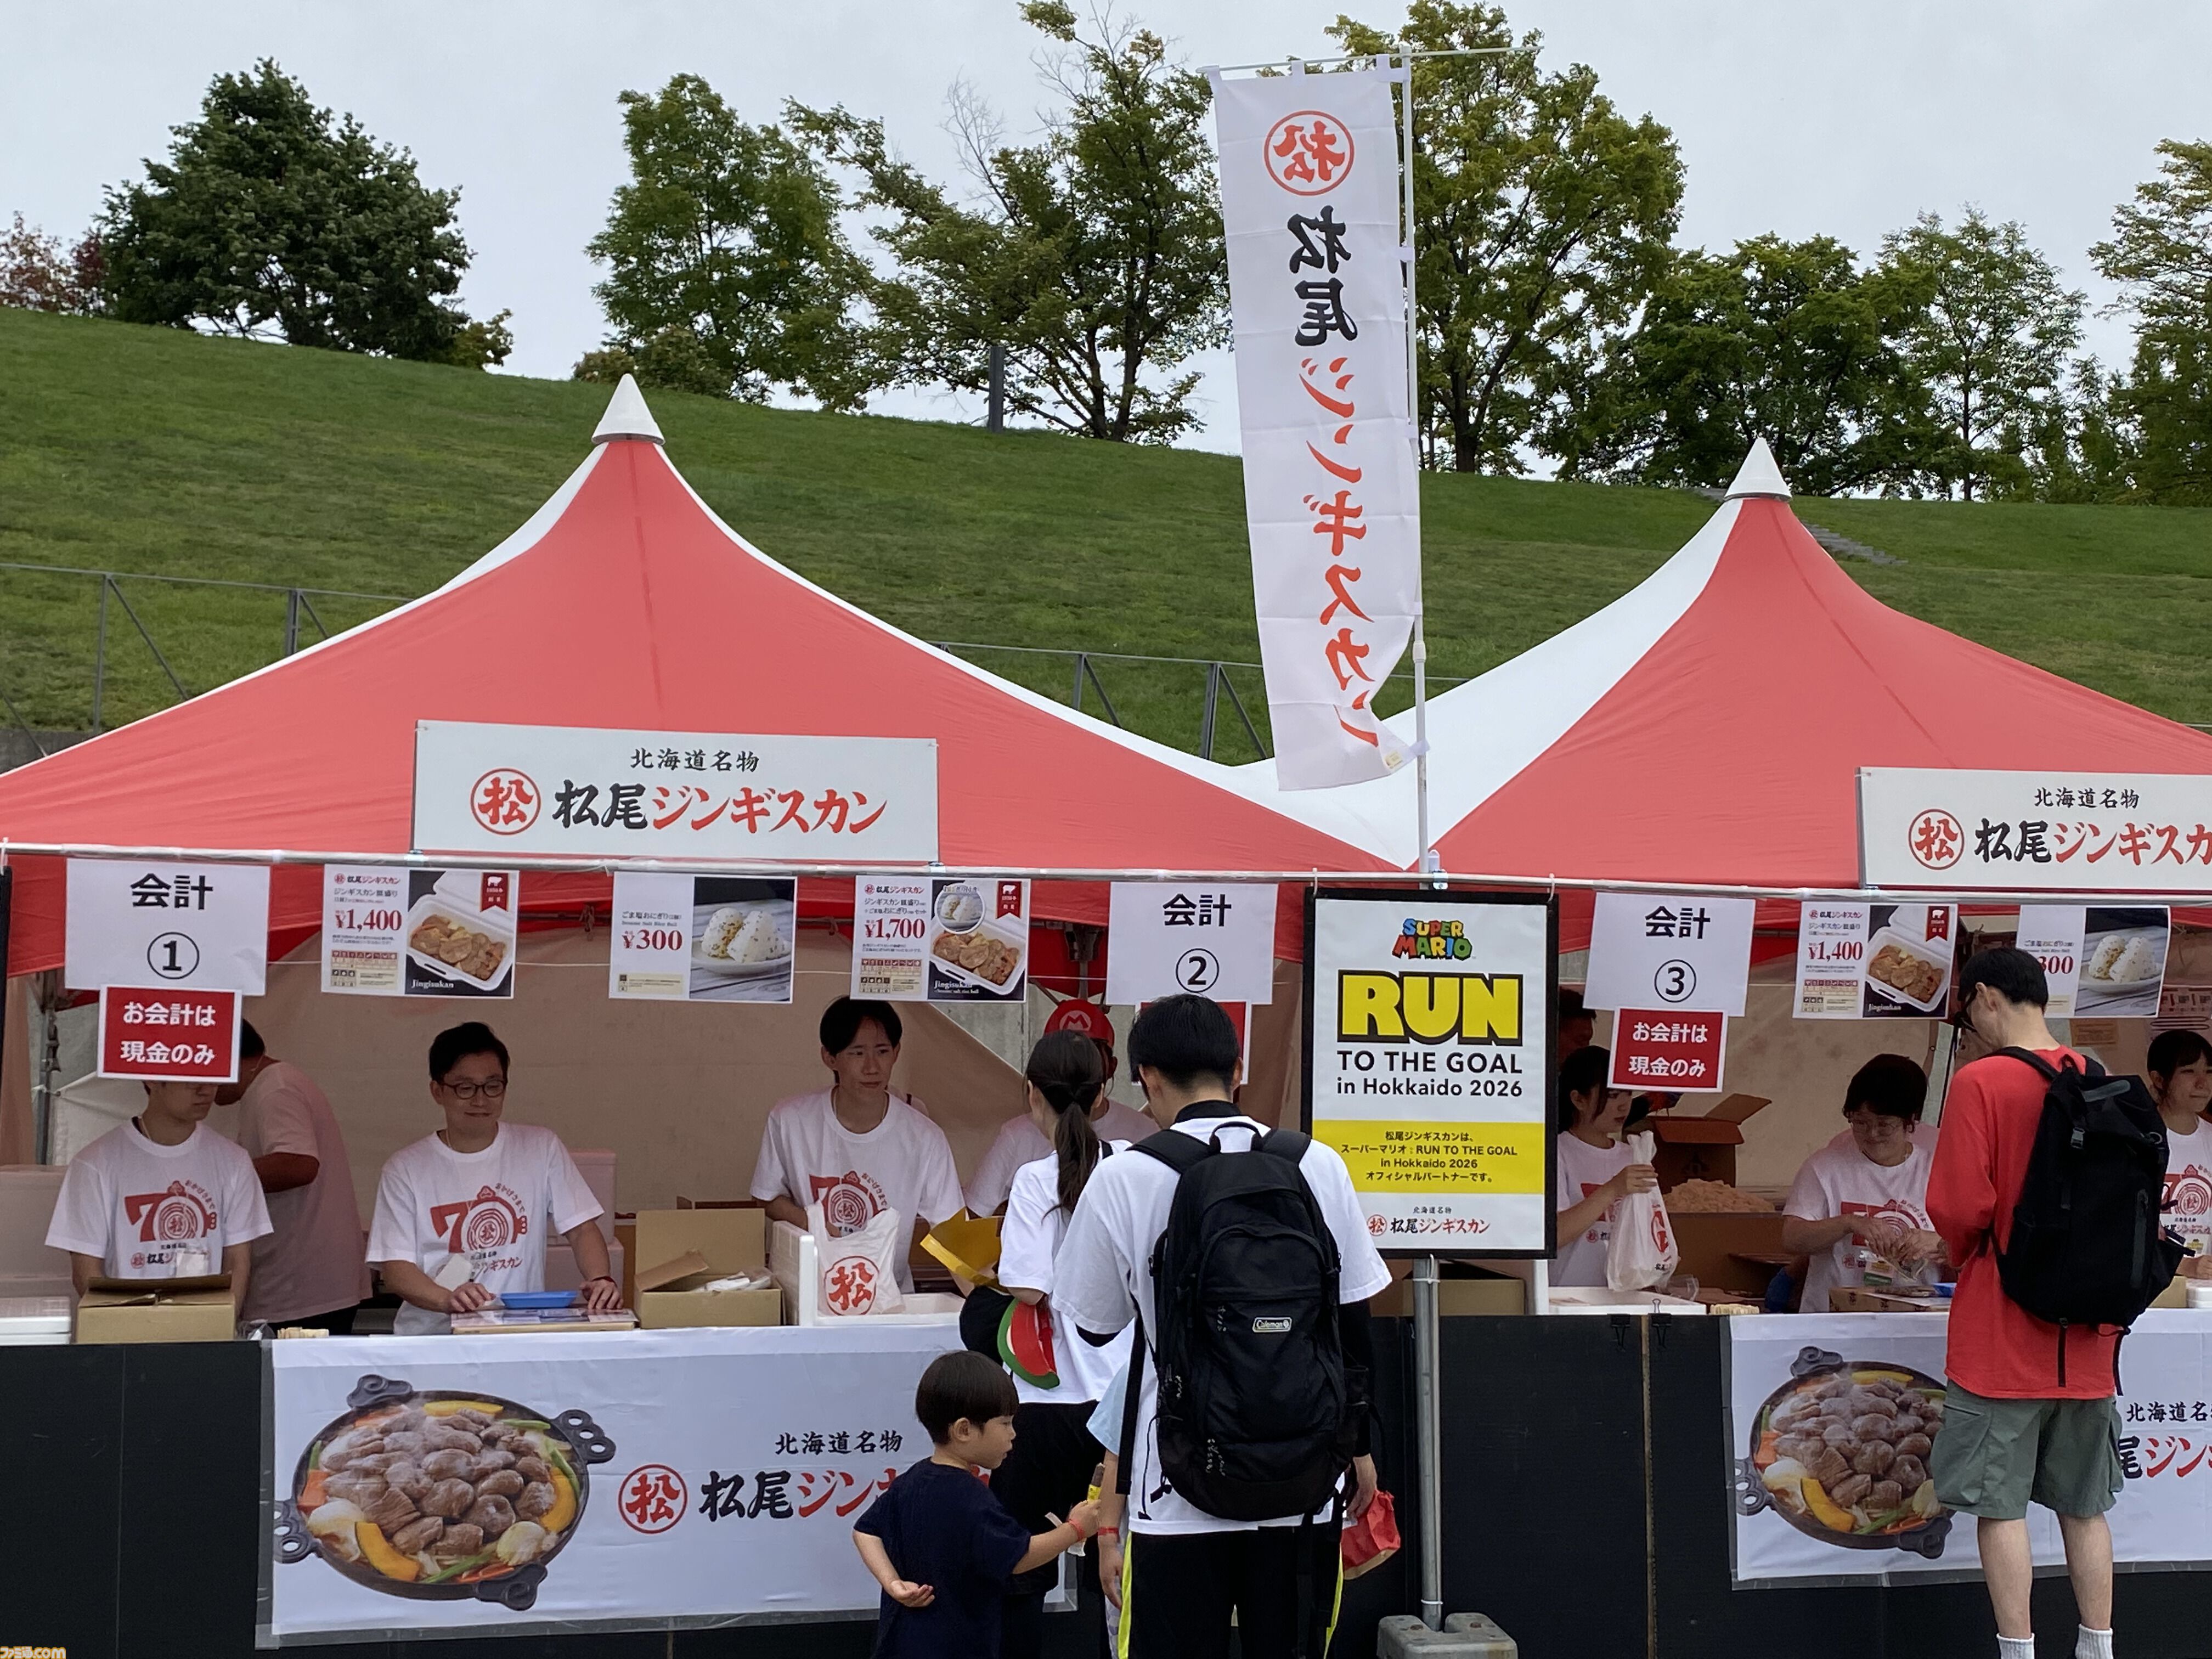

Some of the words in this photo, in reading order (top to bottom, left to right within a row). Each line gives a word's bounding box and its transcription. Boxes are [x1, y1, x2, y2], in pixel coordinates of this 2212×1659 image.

[630, 747, 759, 772] 北海道名物
[470, 768, 541, 835] 松
[552, 779, 887, 835] 松尾ジンギスカン
[2034, 787, 2140, 809] 北海道名物
[1908, 809, 1965, 870] 松
[131, 873, 213, 910] 会計
[335, 909, 402, 932] ¥1,400
[1163, 893, 1232, 928] 会計
[864, 918, 925, 941] ¥1,700
[1402, 918, 1464, 938] SUPER
[1644, 906, 1711, 939] 会計
[622, 929, 683, 951] ¥300
[1392, 934, 1472, 961] MARIO
[1808, 941, 1863, 962] ¥1,400
[123, 1001, 216, 1026] お会計は
[1337, 969, 1523, 1047] RUN
[1632, 1022, 1709, 1044] お会計は
[120, 1042, 215, 1065] 現金のみ
[1337, 1051, 1375, 1072] TO
[1384, 1052, 1436, 1073] THE
[1446, 1052, 1522, 1075] GOAL
[1628, 1055, 1707, 1079] 現金のみ
[1337, 1077, 1356, 1095] in
[1363, 1077, 1463, 1096] Hokkaido
[1470, 1080, 1522, 1097] 2026
[1443, 1146, 1459, 1155] TO
[1463, 1146, 1484, 1155] THE
[1487, 1146, 1518, 1156] GOAL
[1380, 1159, 1391, 1167] in
[1393, 1158, 1446, 1168] Hokkaido
[1449, 1159, 1478, 1169] 2026
[1365, 1171, 1493, 1183] オフィシャルパートナーです。
[1413, 1206, 1452, 1215] 北海道名物
[1390, 1217, 1491, 1235] 松尾ジンギスカン
[2126, 1401, 2212, 1423] 北海道名
[774, 1430, 904, 1455] 北海道名物
[2118, 1435, 2212, 1479] 尾ジン
[618, 1464, 688, 1534] 松
